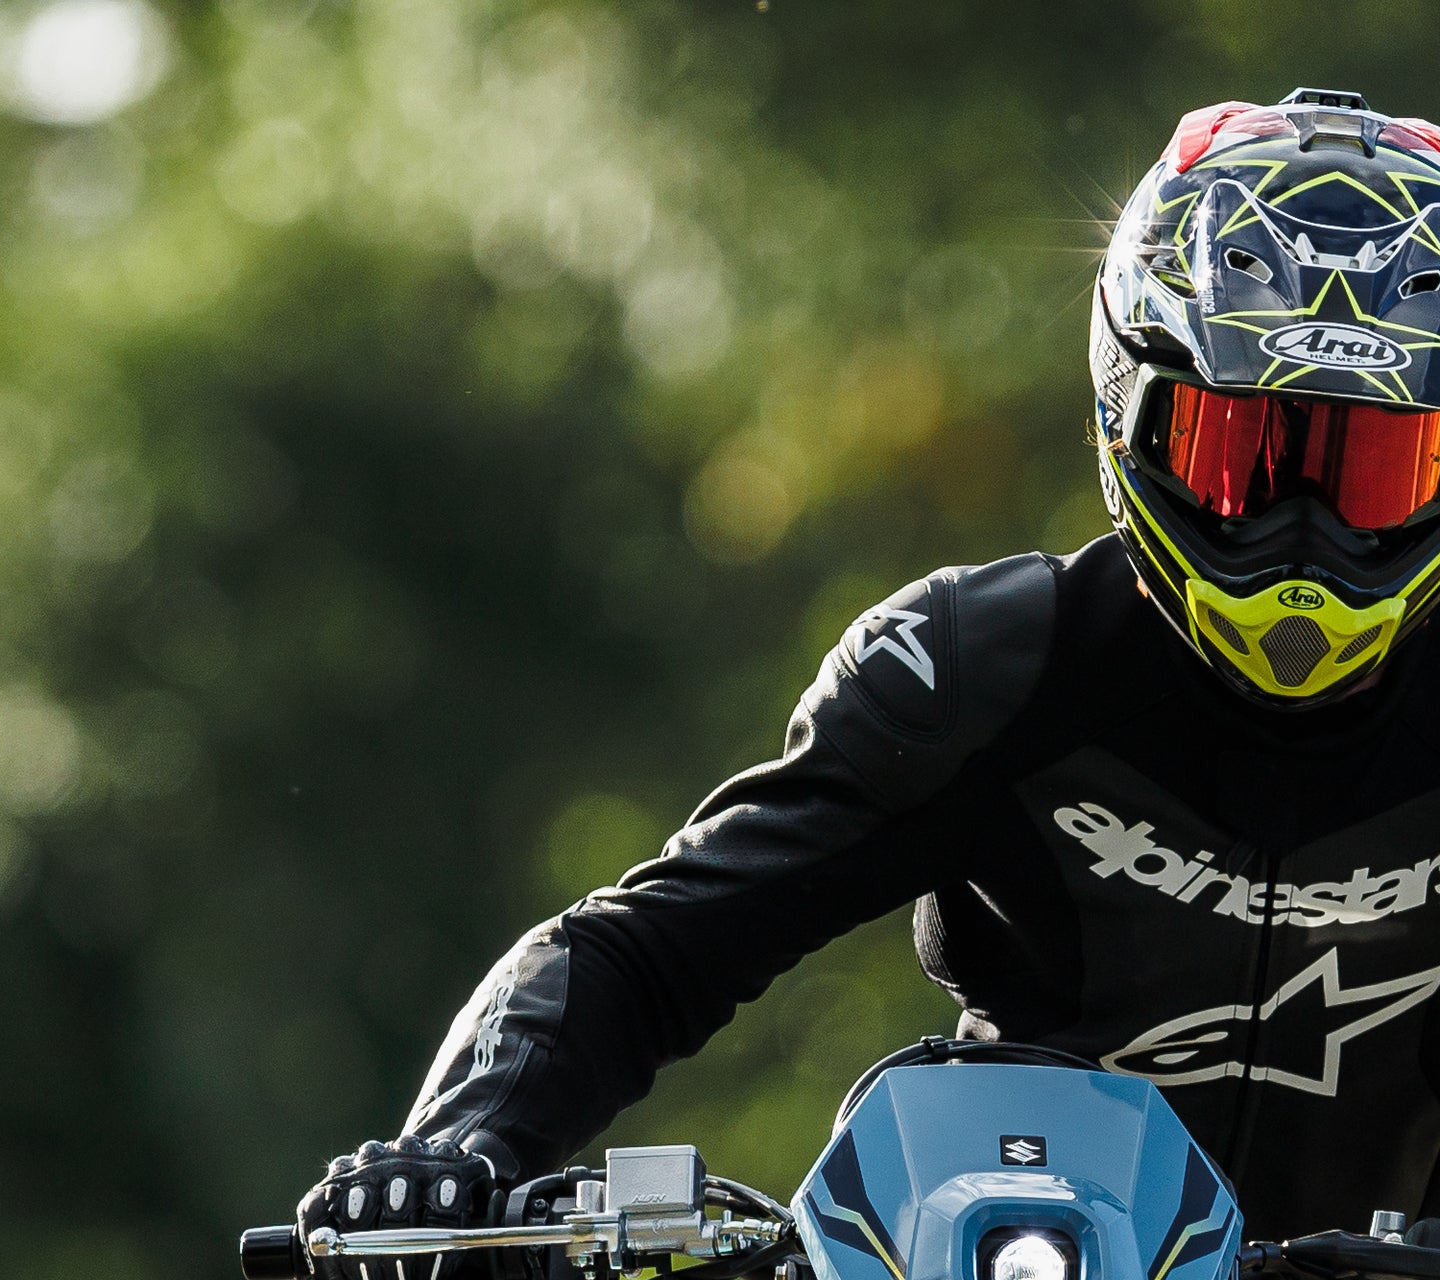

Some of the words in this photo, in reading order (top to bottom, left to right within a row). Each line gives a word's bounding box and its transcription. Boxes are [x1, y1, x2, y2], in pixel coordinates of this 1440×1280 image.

[1273, 328, 1391, 360] Arai
[1309, 353, 1364, 364] HELMET
[1282, 588, 1320, 605] Arai
